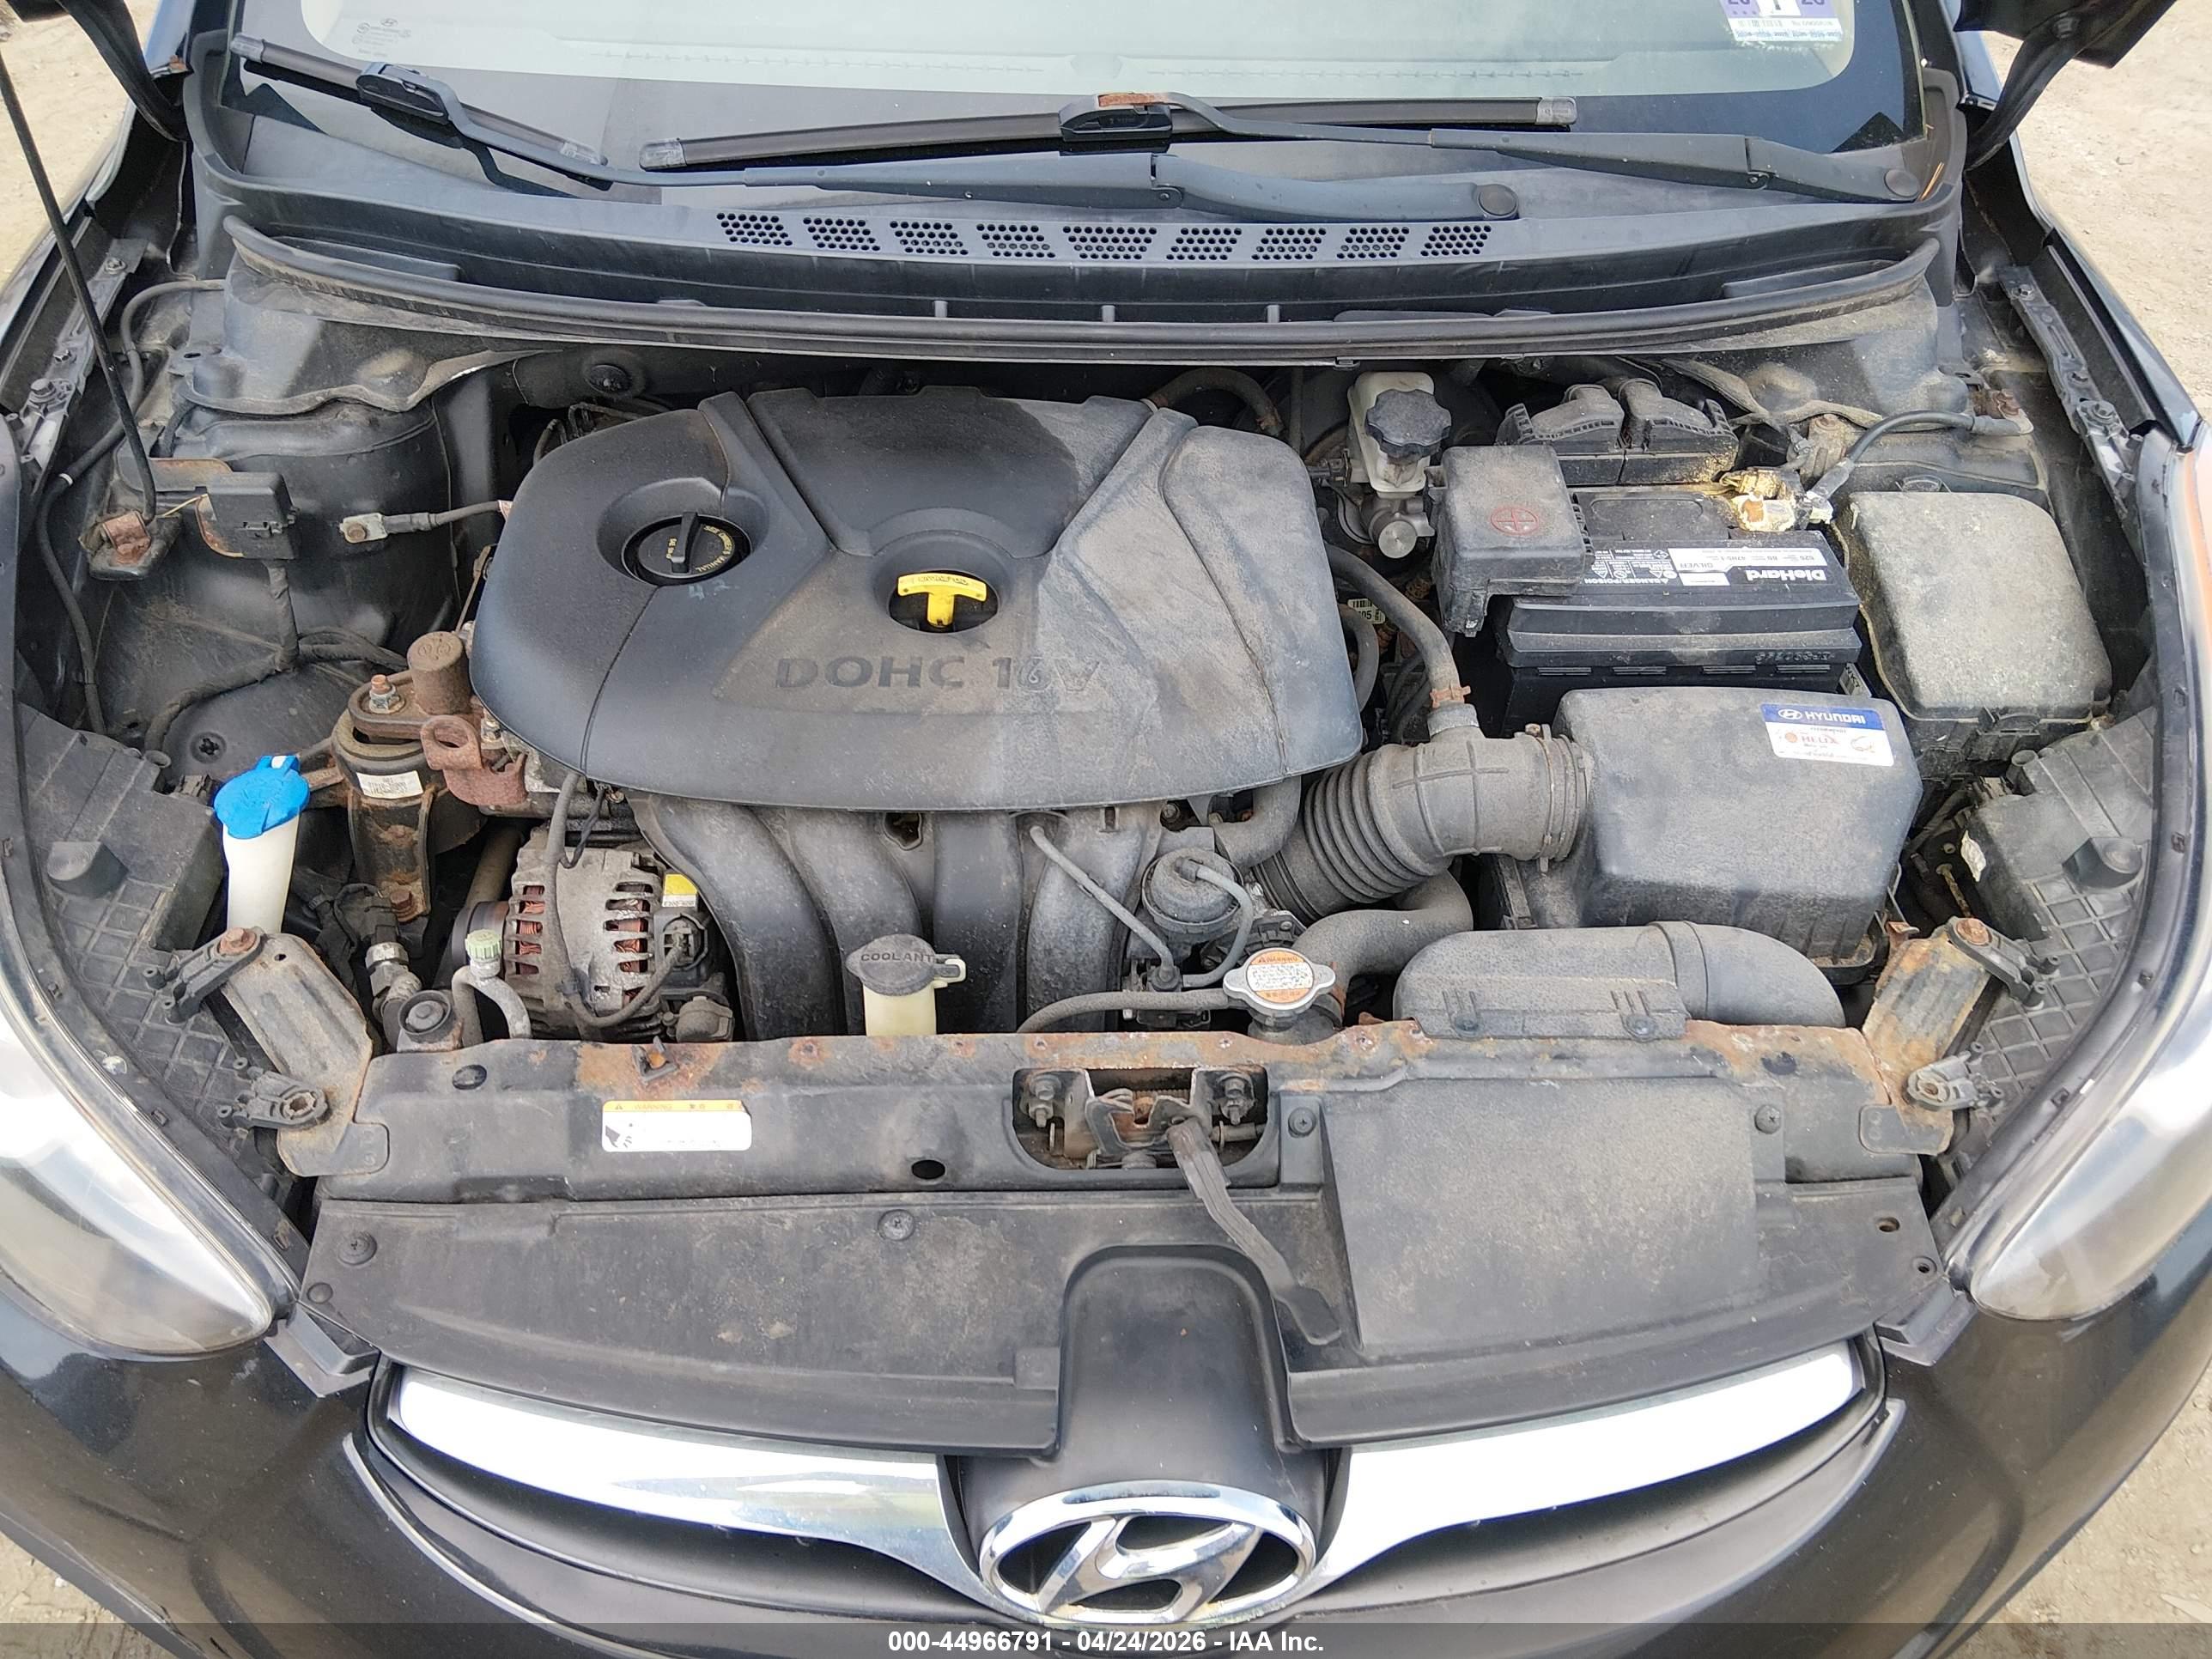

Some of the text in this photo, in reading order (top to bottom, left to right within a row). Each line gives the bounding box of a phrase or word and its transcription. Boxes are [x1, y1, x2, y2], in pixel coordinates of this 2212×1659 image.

[695, 553, 728, 573] MANUAL
[1745, 568, 1827, 581] DieHard
[775, 655, 965, 689] DOHC
[1804, 710, 1866, 725] HYUNDAI
[860, 952, 935, 963] COOLANT
